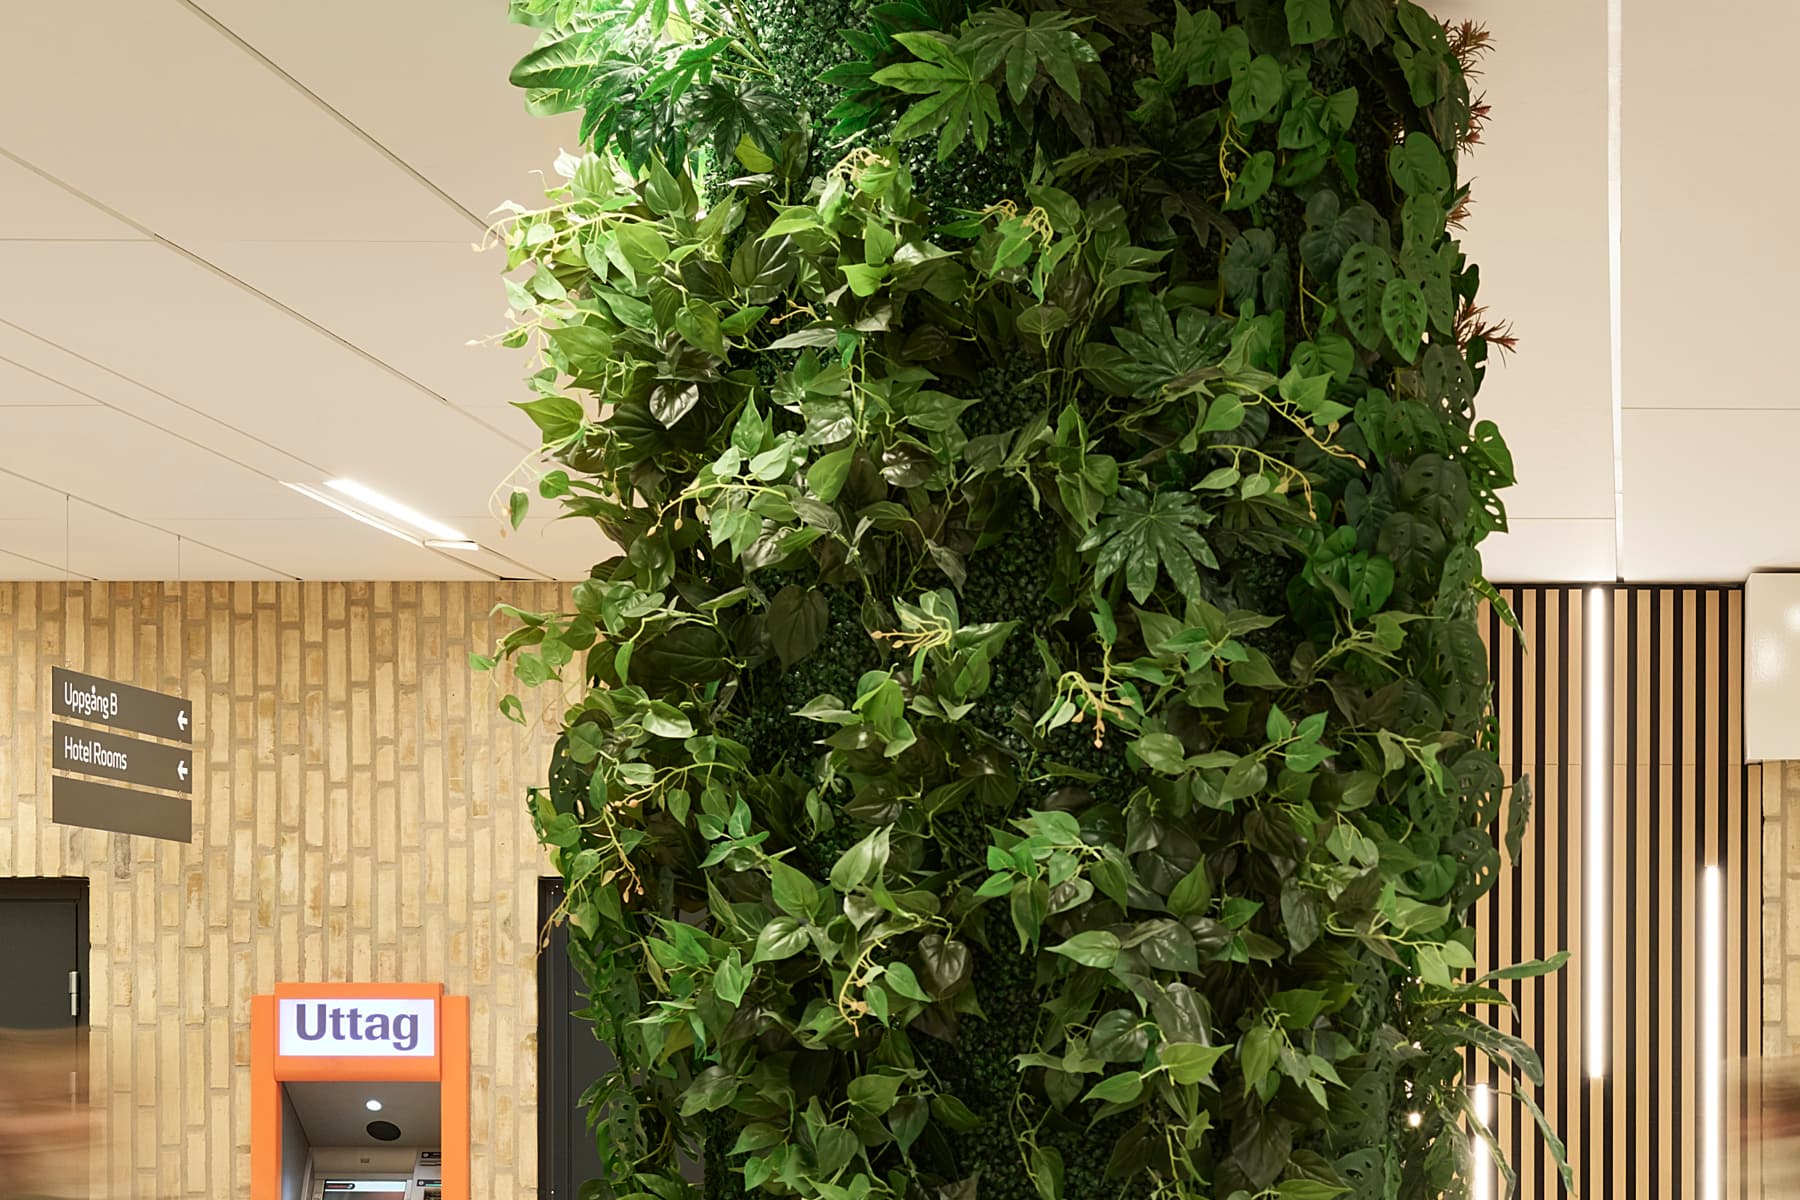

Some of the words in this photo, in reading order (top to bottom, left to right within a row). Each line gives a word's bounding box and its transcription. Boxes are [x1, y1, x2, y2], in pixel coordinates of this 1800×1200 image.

[64, 682, 109, 720] Uppgång
[110, 692, 118, 716] B
[64, 736, 92, 763] Hotel
[93, 742, 128, 770] Rooms
[296, 1004, 419, 1051] Uttag
